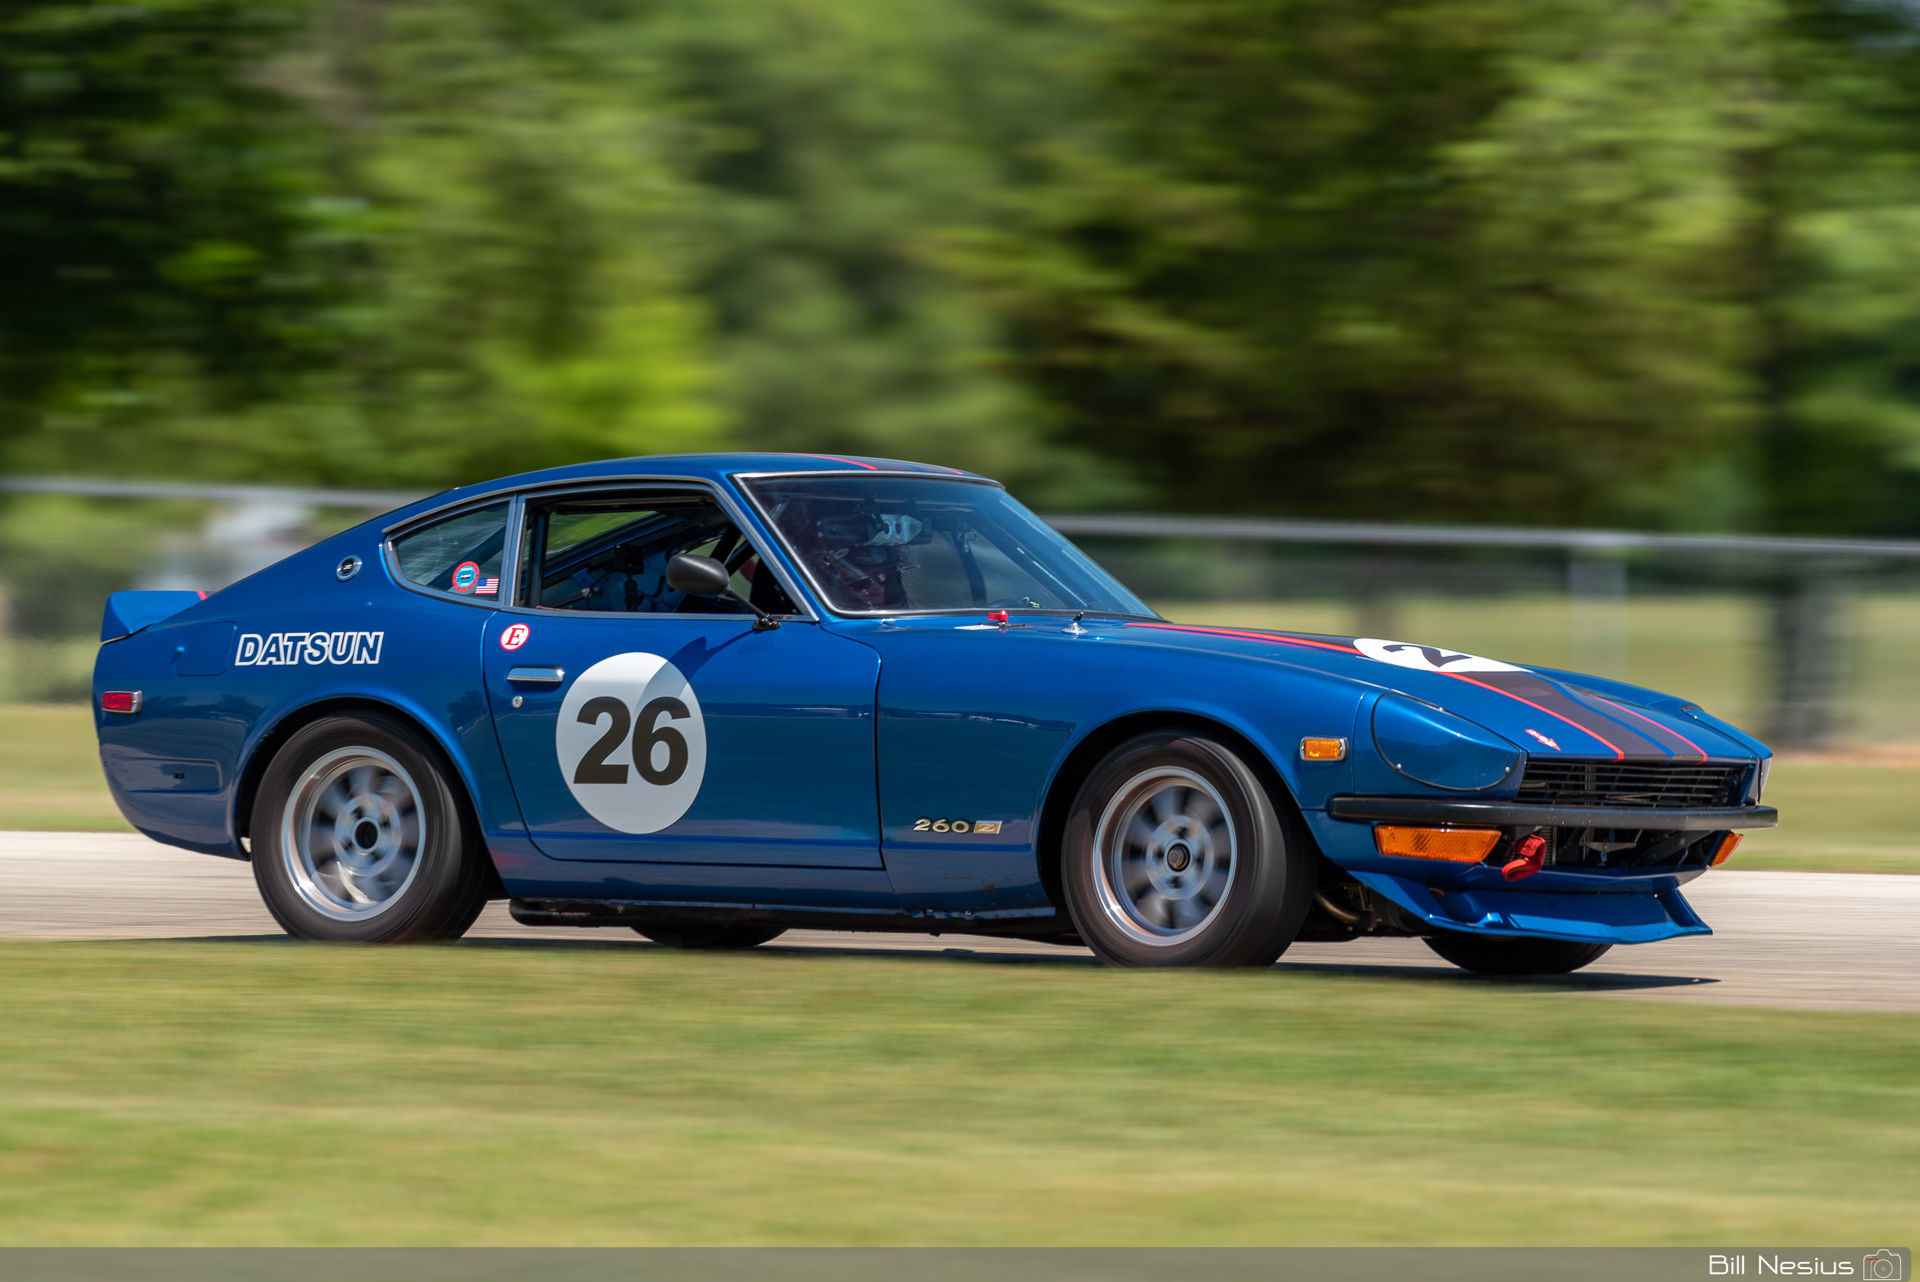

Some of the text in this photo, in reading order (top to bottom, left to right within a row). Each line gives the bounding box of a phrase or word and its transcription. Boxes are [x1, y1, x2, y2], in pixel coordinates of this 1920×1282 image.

[234, 631, 385, 667] DATSUN
[505, 627, 525, 646] E
[573, 695, 691, 786] 26
